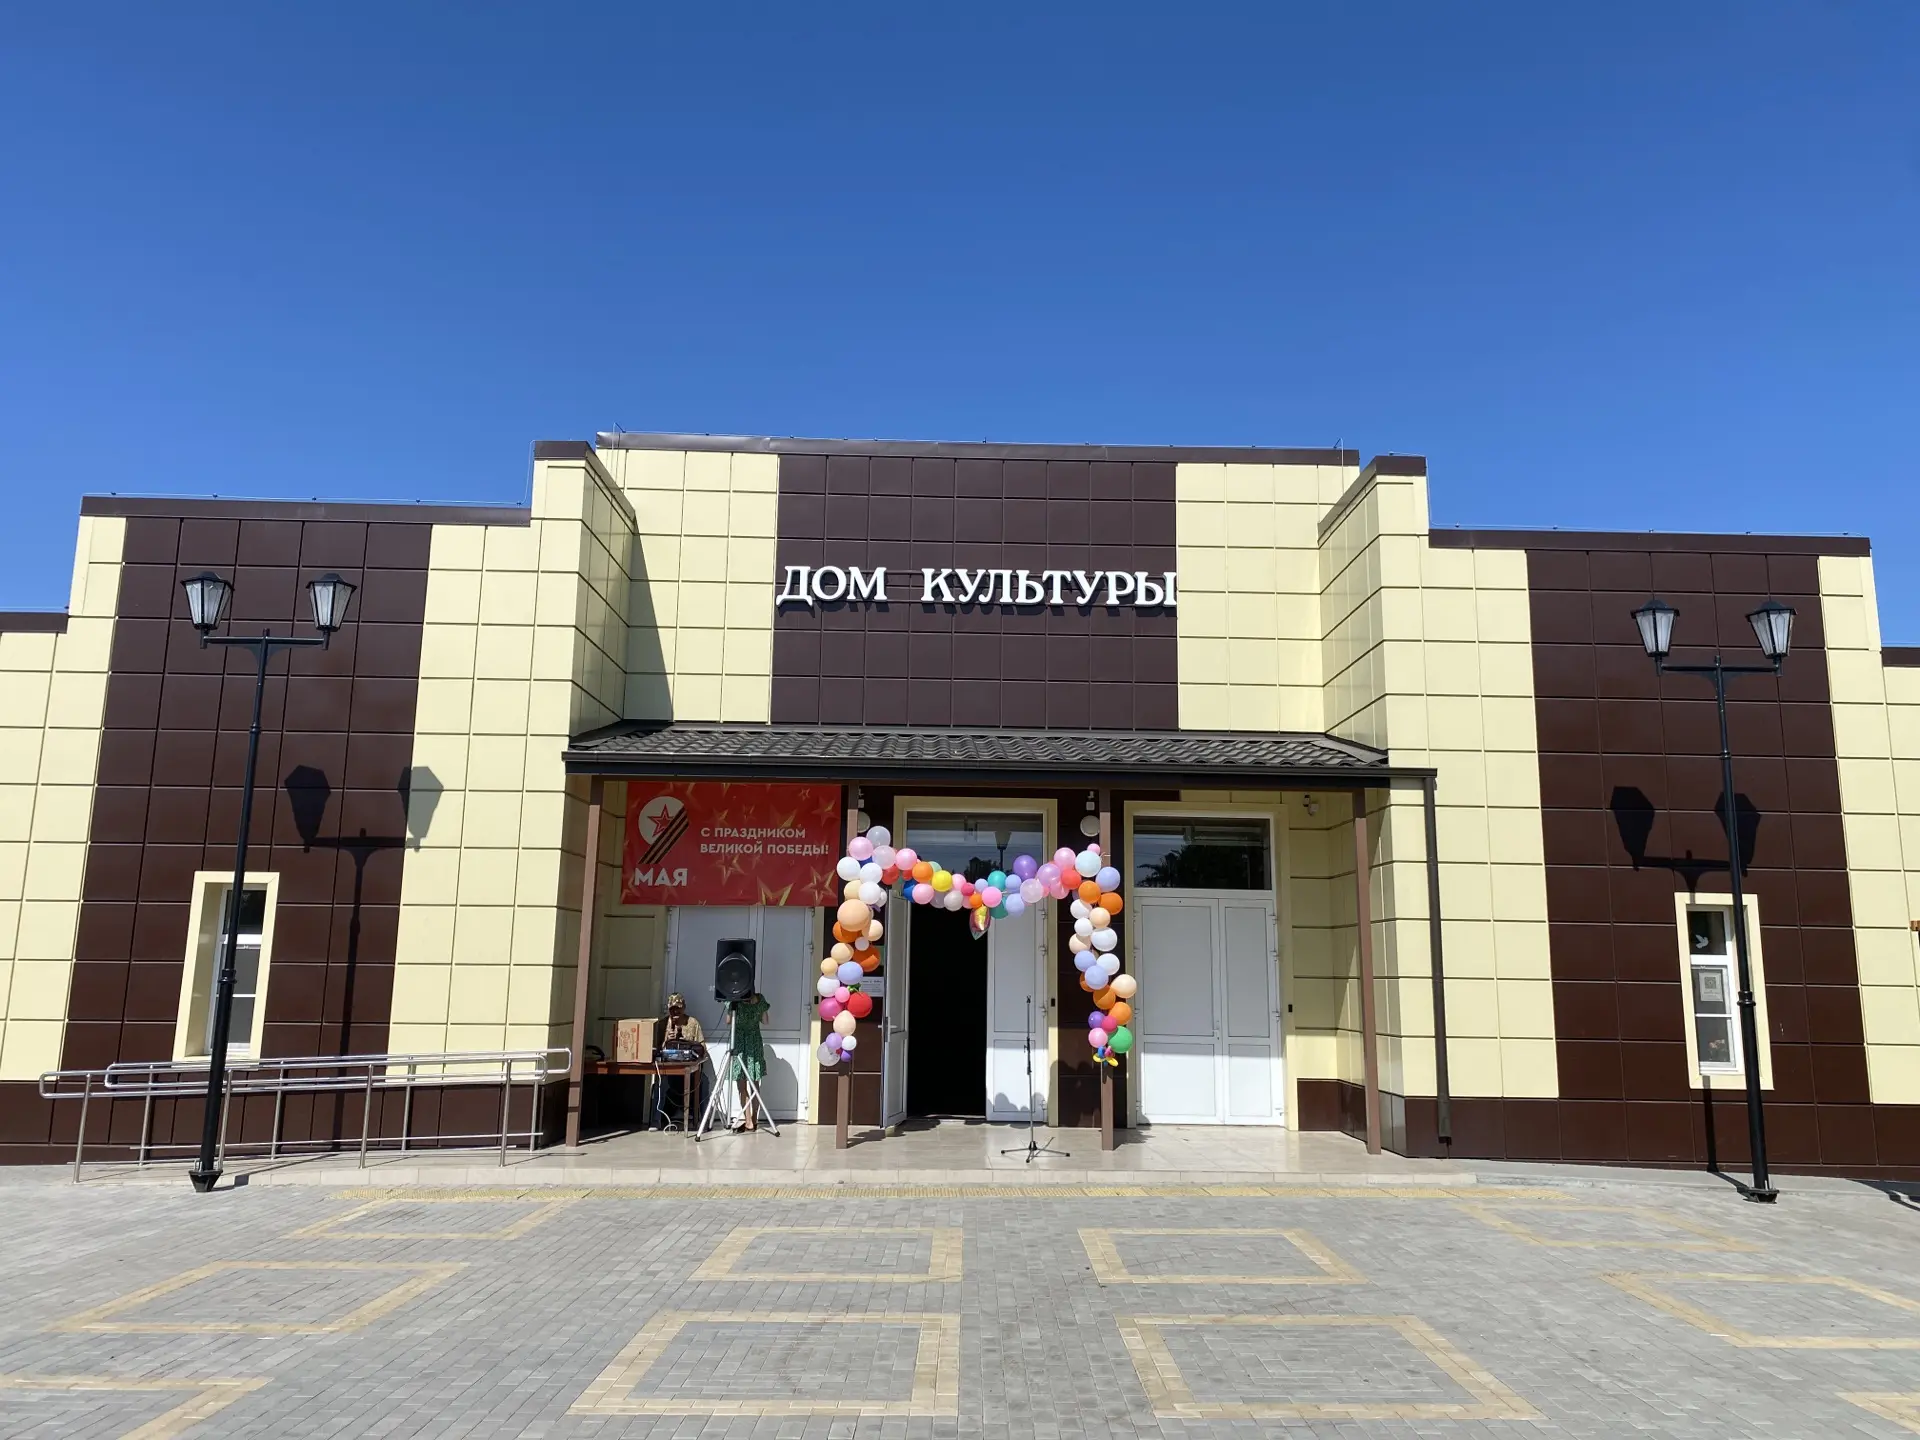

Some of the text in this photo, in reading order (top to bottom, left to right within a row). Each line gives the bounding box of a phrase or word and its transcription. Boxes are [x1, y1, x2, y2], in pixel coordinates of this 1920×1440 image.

[776, 565, 1178, 607] ДОМ КУЛЬТУРЫ
[700, 827, 806, 840] С ПРАЗДНИКОМ
[700, 841, 829, 856] ВЕЛИКОЙ ПОБЕДЫ!
[634, 867, 689, 888] МАЯ
